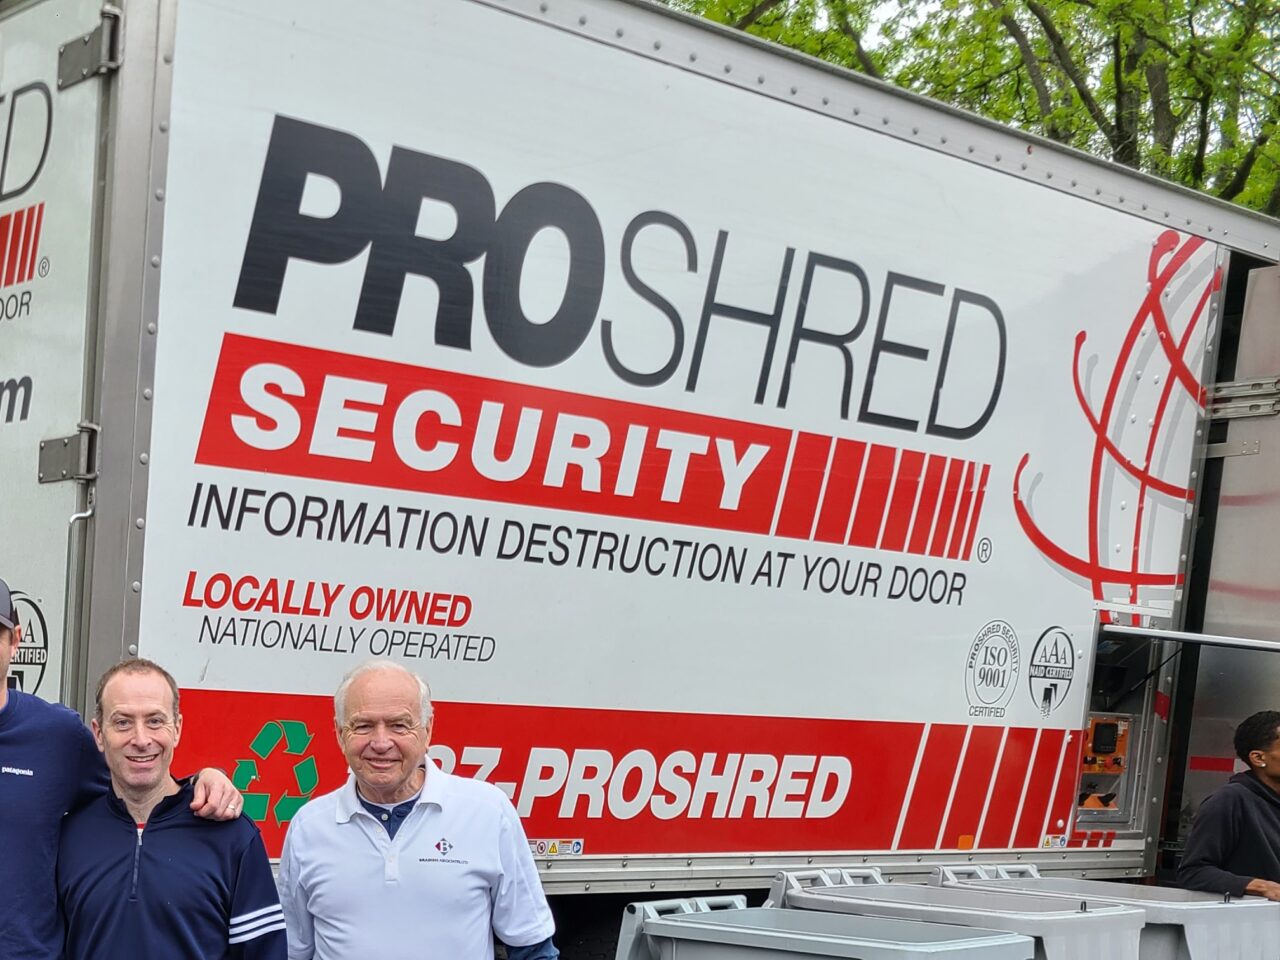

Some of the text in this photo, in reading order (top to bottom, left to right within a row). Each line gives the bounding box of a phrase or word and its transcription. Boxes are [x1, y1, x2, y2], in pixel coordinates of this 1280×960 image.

[232, 114, 1008, 440] PROSHRED
[230, 362, 771, 512] SECURITY
[187, 482, 967, 606] INFORMATION DESTRUCTION AT YOUR DOOR
[182, 571, 473, 628] LOCALLY OWNED
[10, 649, 47, 664] ERTIFIED
[198, 615, 497, 662] NATIONALLY OPERATED
[968, 624, 1001, 669] PROSHRED
[982, 646, 1008, 667] ISO
[1038, 637, 1067, 665] AAA
[977, 667, 1006, 688] 9001
[1046, 668, 1073, 679] CERTIFIED
[968, 705, 1006, 718] CERTIFIED
